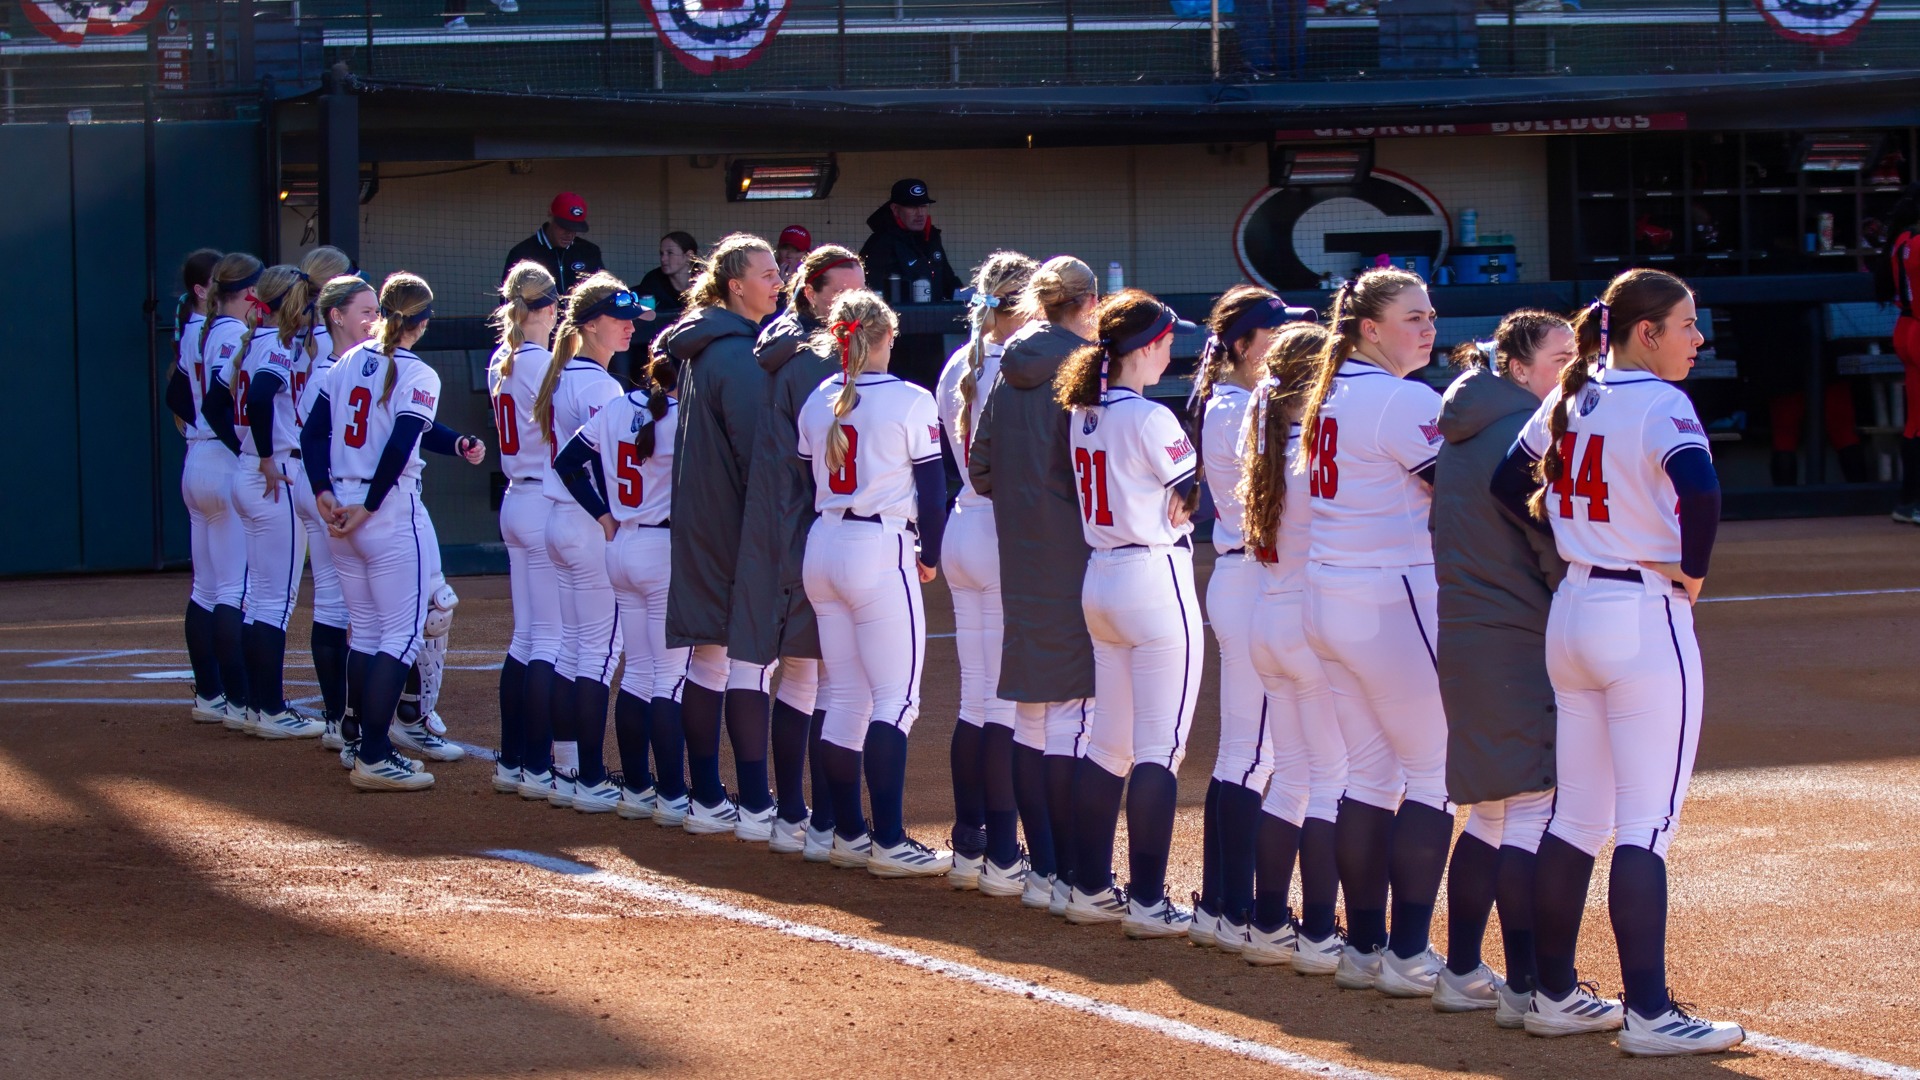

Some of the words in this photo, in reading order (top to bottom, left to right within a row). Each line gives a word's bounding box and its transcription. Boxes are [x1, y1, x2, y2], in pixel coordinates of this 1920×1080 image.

[344, 386, 372, 449] 3
[494, 393, 520, 456] 0
[617, 440, 643, 508] 5
[1075, 446, 1114, 527] 31
[1310, 415, 1339, 500] 28
[1551, 431, 1610, 523] 44
